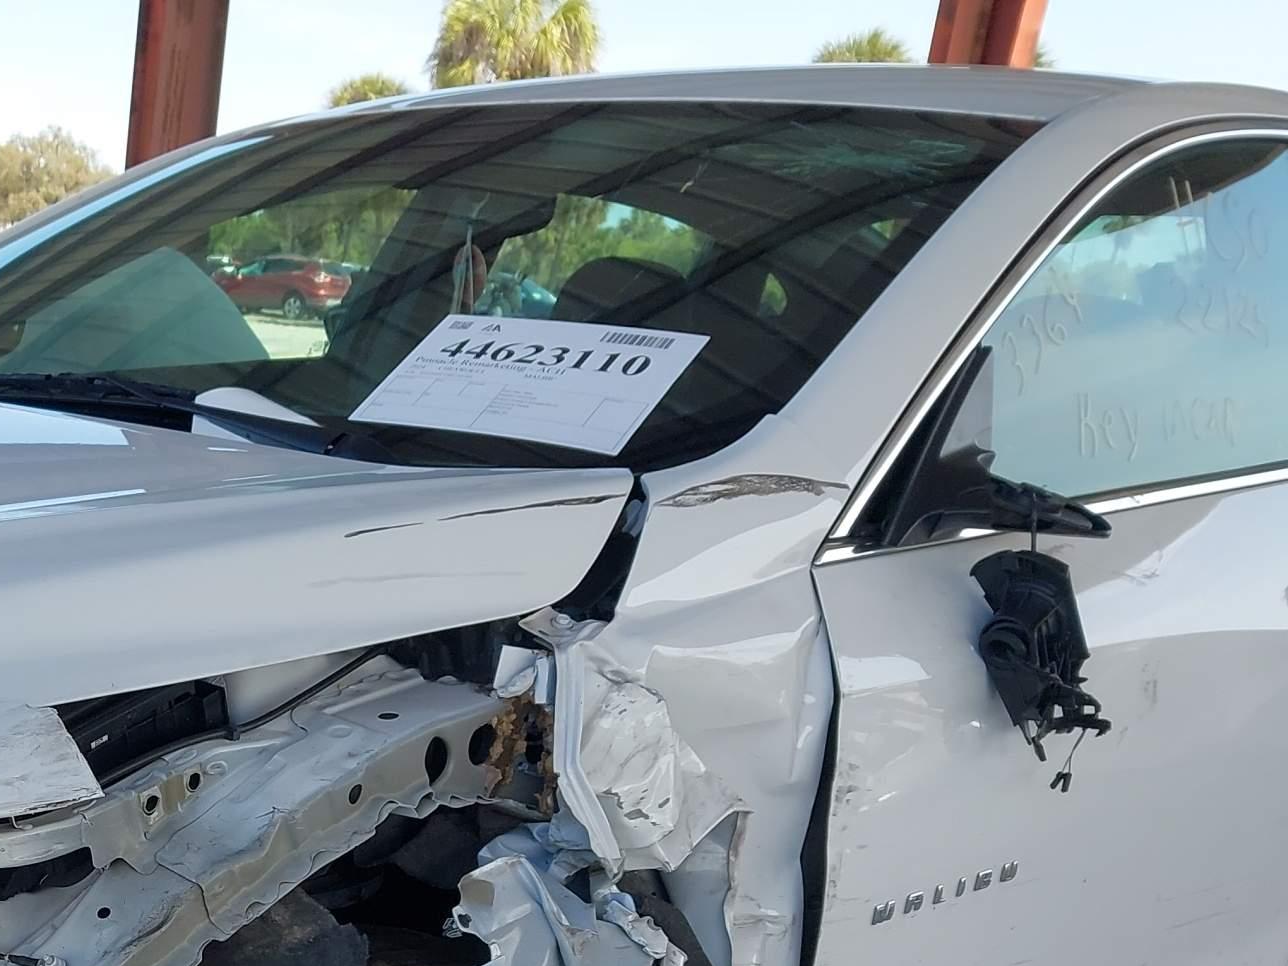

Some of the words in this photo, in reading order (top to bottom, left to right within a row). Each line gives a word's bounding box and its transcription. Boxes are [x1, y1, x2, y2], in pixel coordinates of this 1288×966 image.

[440, 338, 652, 376] 44623110
[461, 359, 527, 373] Remarketing
[871, 860, 1019, 926] MALIBU
